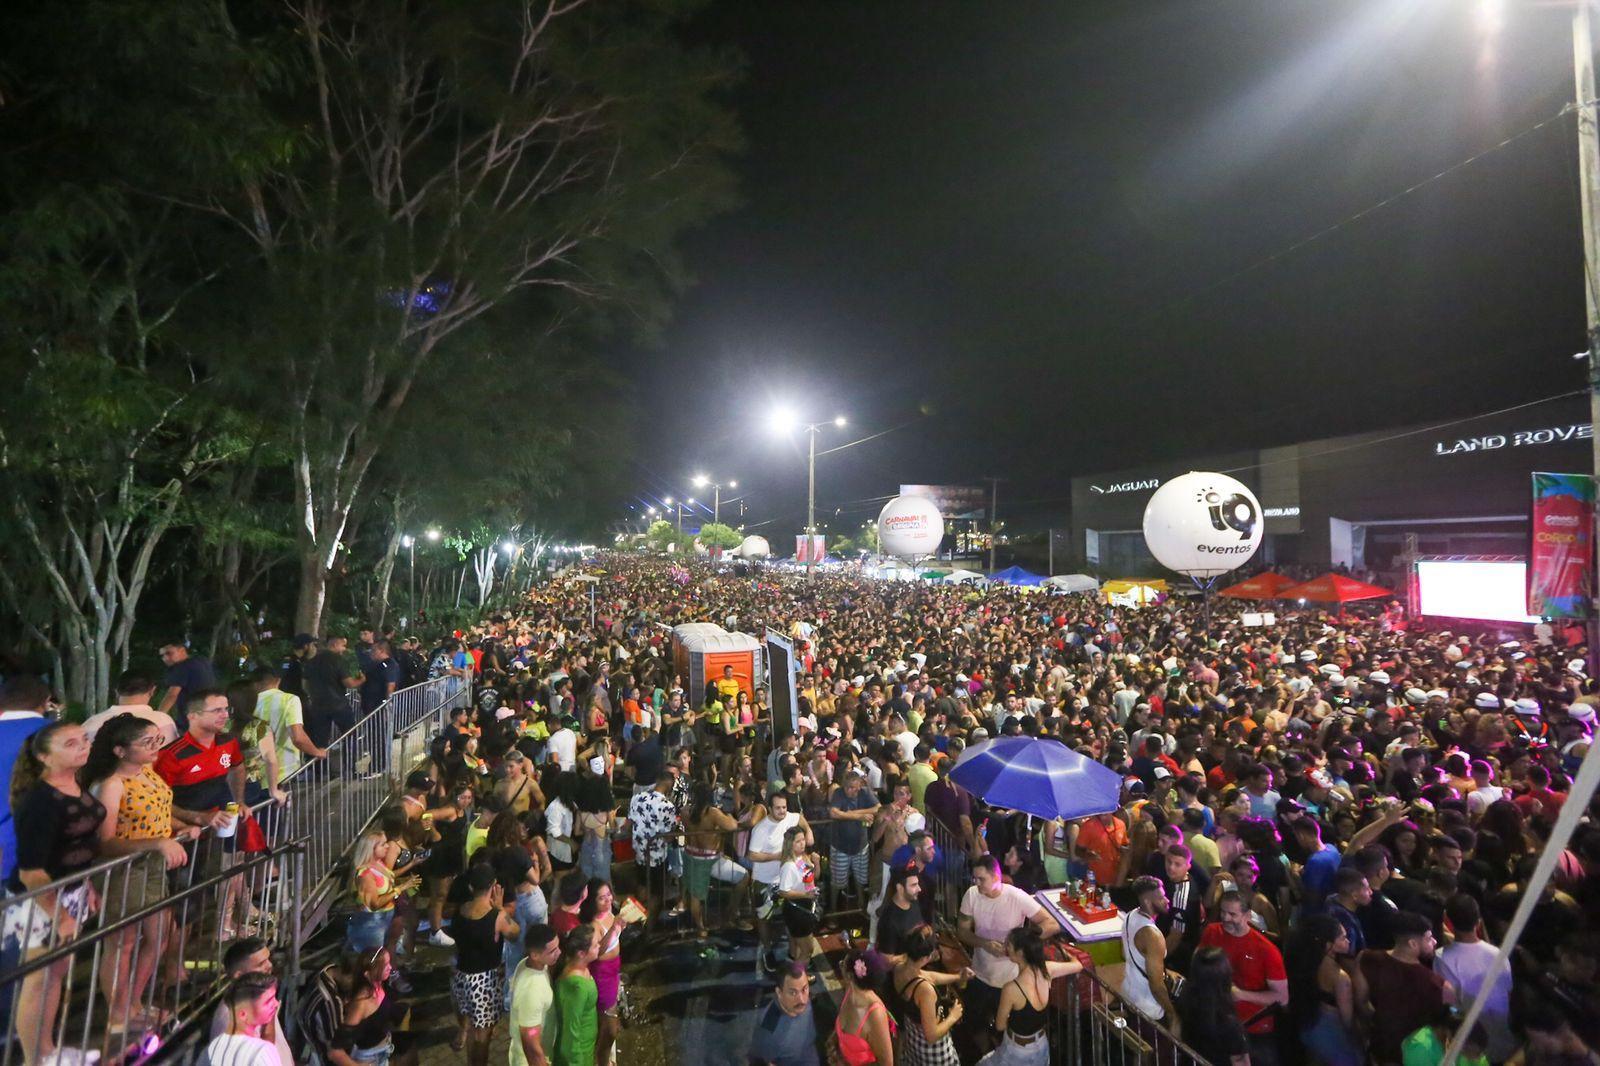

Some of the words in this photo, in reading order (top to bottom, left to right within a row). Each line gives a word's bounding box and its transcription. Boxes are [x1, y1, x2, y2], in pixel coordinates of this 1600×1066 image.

[1435, 435, 1507, 456] LAND
[1105, 479, 1159, 494] JAGUAR
[1197, 544, 1251, 555] eventos
